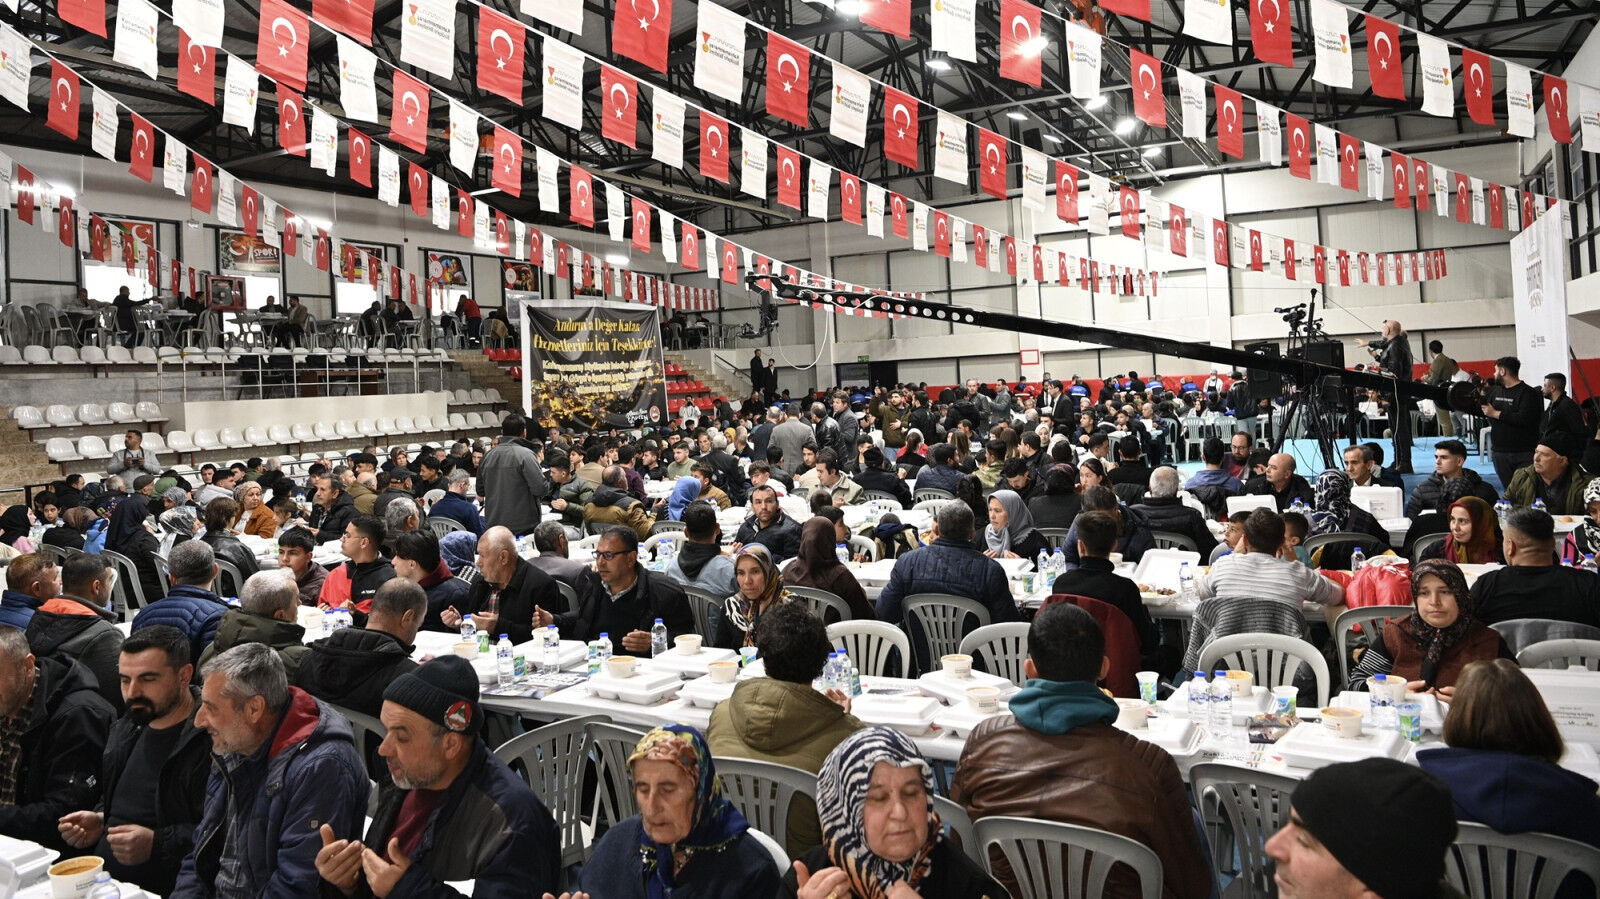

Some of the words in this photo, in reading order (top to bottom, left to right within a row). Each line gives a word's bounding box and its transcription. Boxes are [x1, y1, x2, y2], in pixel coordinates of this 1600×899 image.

[594, 317, 618, 335] Değer
[618, 319, 641, 332] Katan
[594, 334, 610, 355] İçin
[612, 336, 656, 354] Teşekkürer!
